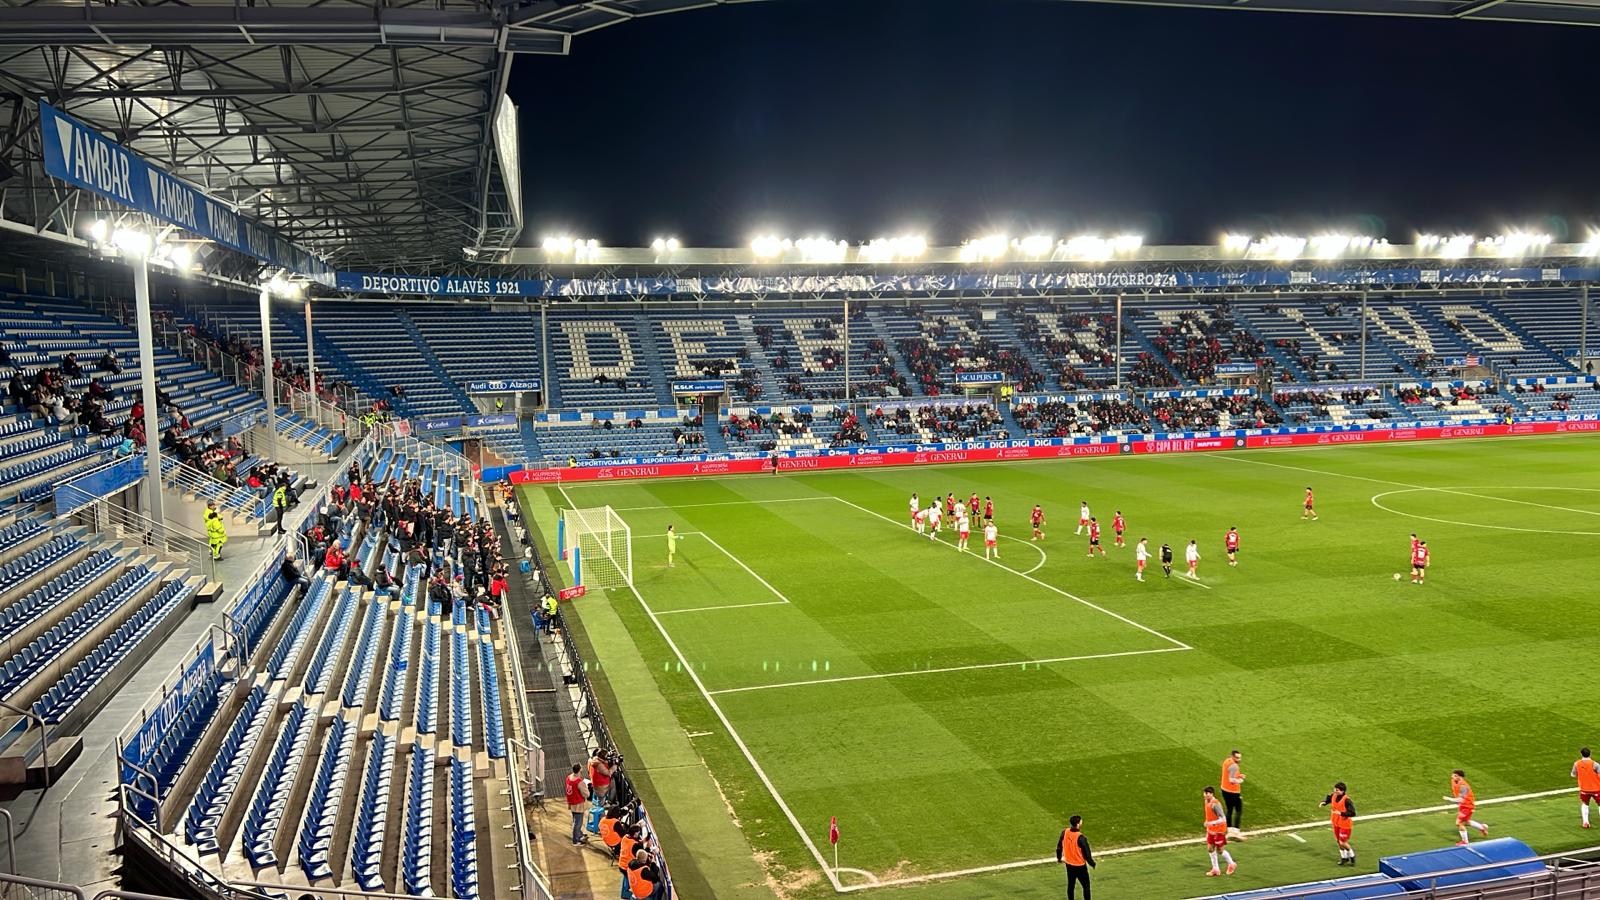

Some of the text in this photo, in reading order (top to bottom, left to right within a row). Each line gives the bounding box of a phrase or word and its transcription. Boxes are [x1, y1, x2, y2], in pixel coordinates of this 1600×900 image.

[75, 128, 134, 203] AMBAR
[160, 175, 198, 230] AMBAR
[213, 205, 240, 248] AMBAR
[362, 276, 520, 294] DEPORTIVO ALAVÉS 1921
[509, 381, 538, 389] Alzaga
[1332, 434, 1364, 442] GENERALI
[1074, 446, 1109, 454] GENERALI
[1156, 440, 1194, 452] COPA DEL REY
[931, 452, 967, 461] GENERALI
[779, 459, 818, 468] GENERALI
[617, 466, 659, 477] GENERALI
[140, 658, 207, 761] Audi Alzaga
